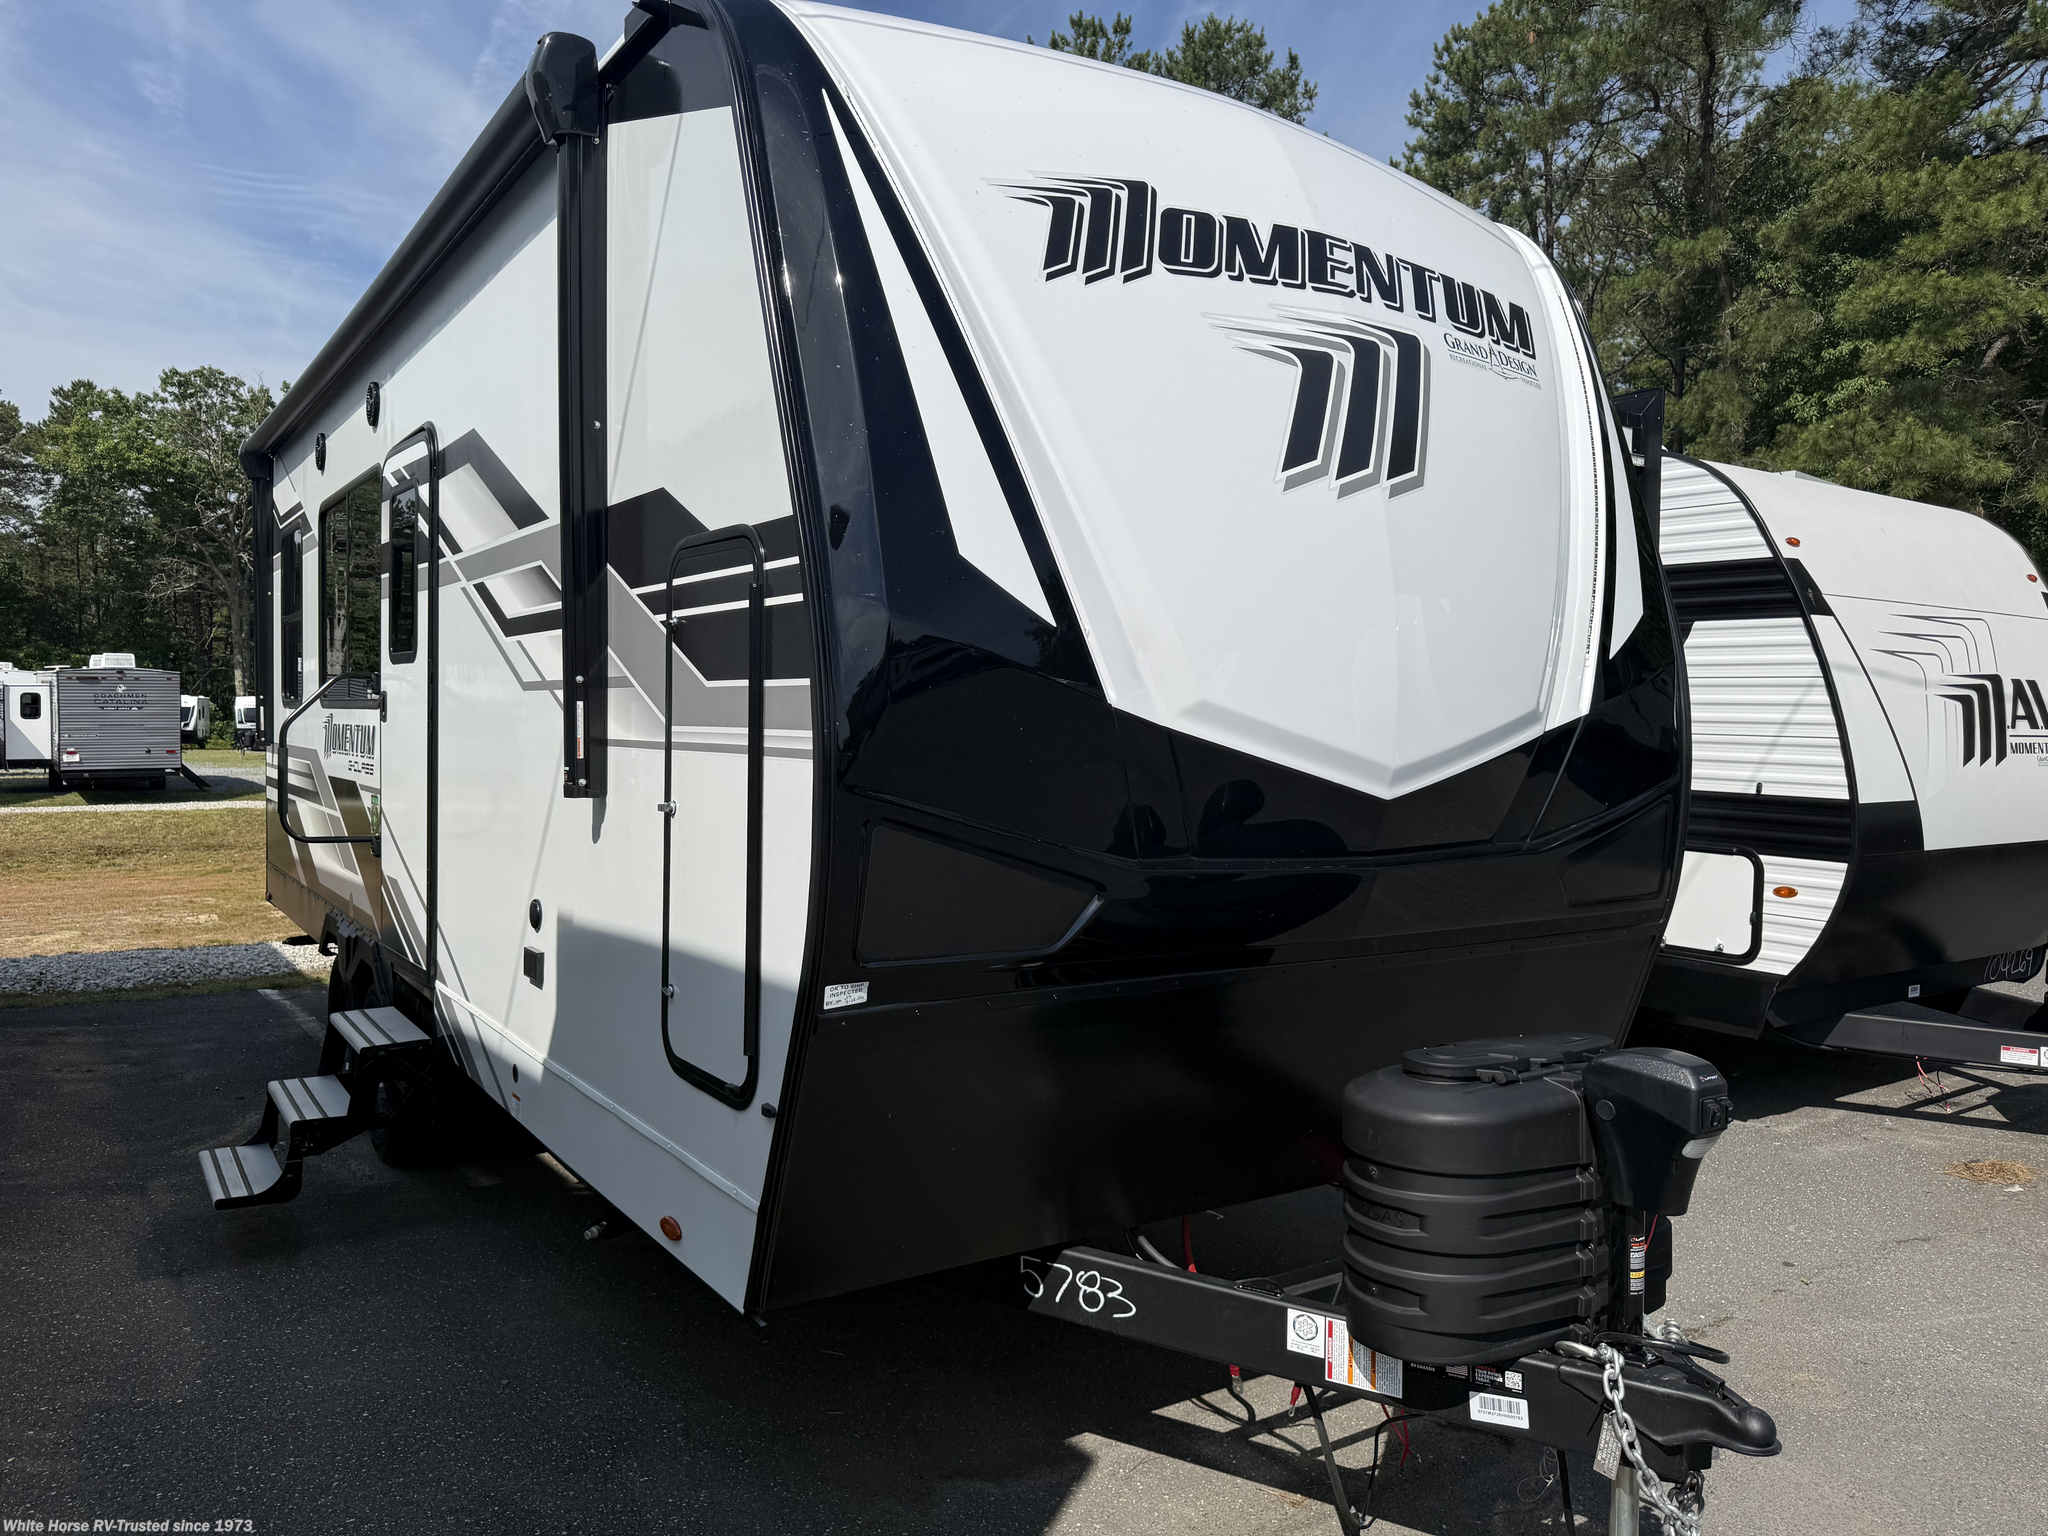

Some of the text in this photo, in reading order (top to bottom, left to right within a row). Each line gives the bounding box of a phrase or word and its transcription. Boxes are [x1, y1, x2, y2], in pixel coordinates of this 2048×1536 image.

[985, 171, 1536, 360] MOMENTUM
[1443, 332, 1538, 377] GRAND DESIGN
[322, 713, 376, 760] MOMENTUM
[829, 987, 863, 998] INSPECTED
[1021, 1255, 1137, 1318] 5783
